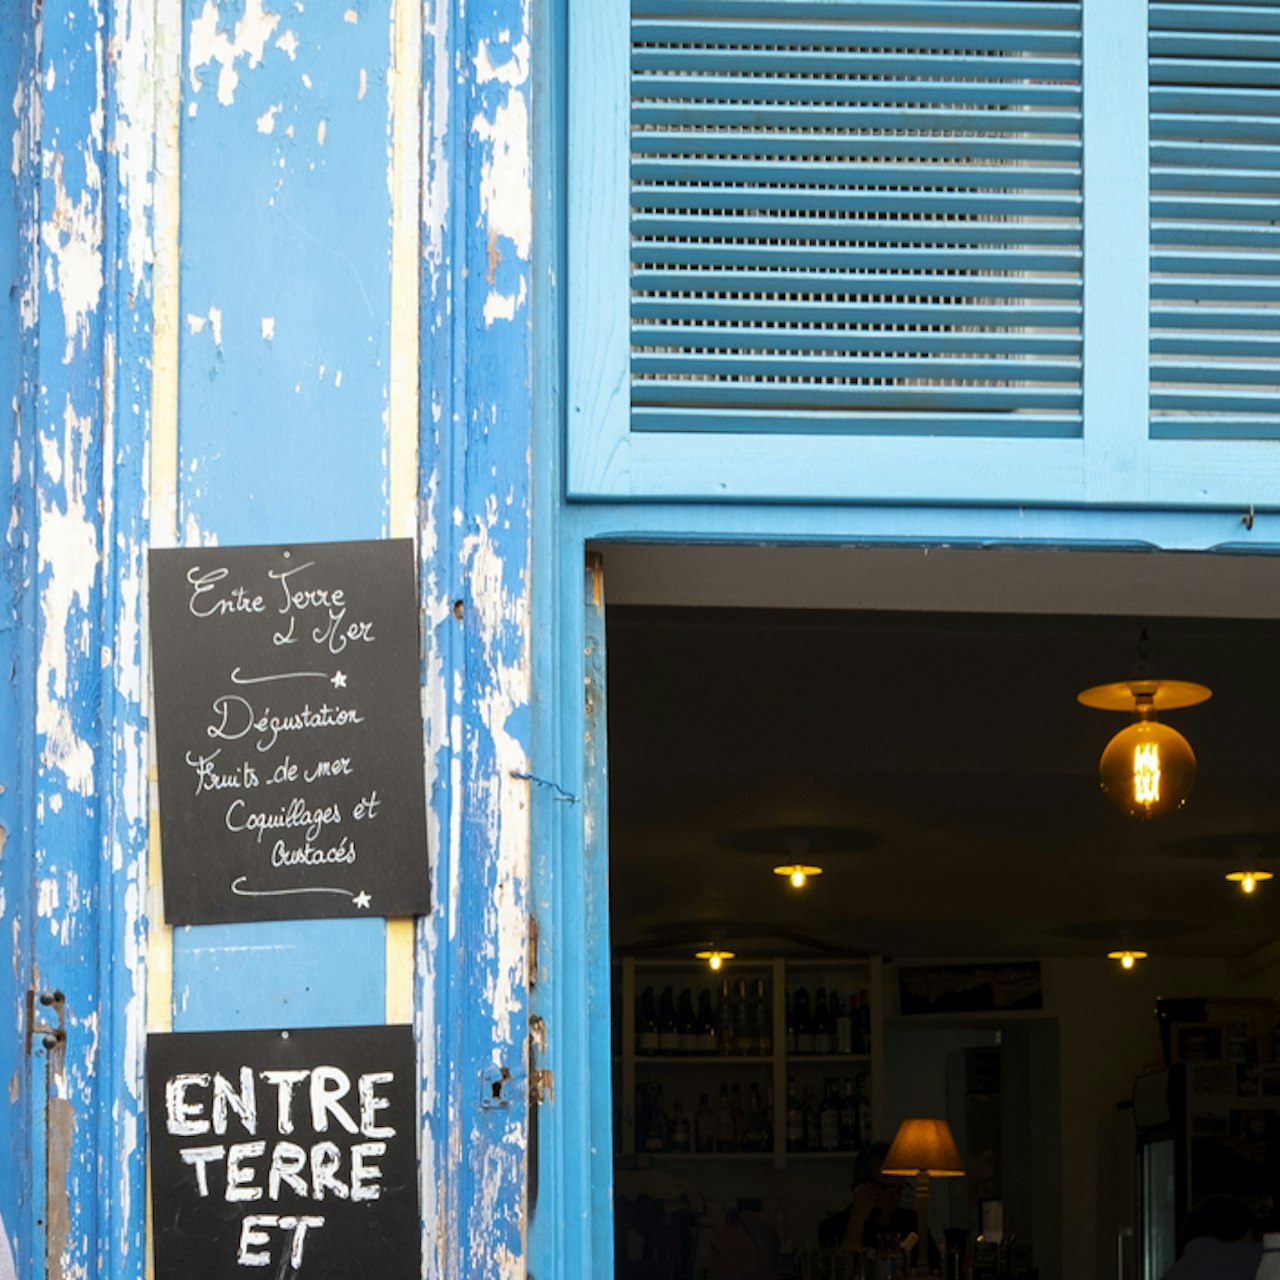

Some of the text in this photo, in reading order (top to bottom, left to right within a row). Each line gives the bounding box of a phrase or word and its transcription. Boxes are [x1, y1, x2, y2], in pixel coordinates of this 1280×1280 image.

[187, 561, 345, 617] Entre Terre
[312, 607, 376, 654] Mer
[207, 695, 365, 752] Dégustation
[185, 748, 260, 796] Fruits
[303, 757, 354, 783] mer
[225, 790, 381, 843] Coquillages et
[166, 1065, 398, 1139] ENTRE
[179, 1140, 388, 1203] TERRE
[237, 1214, 326, 1270] ET
